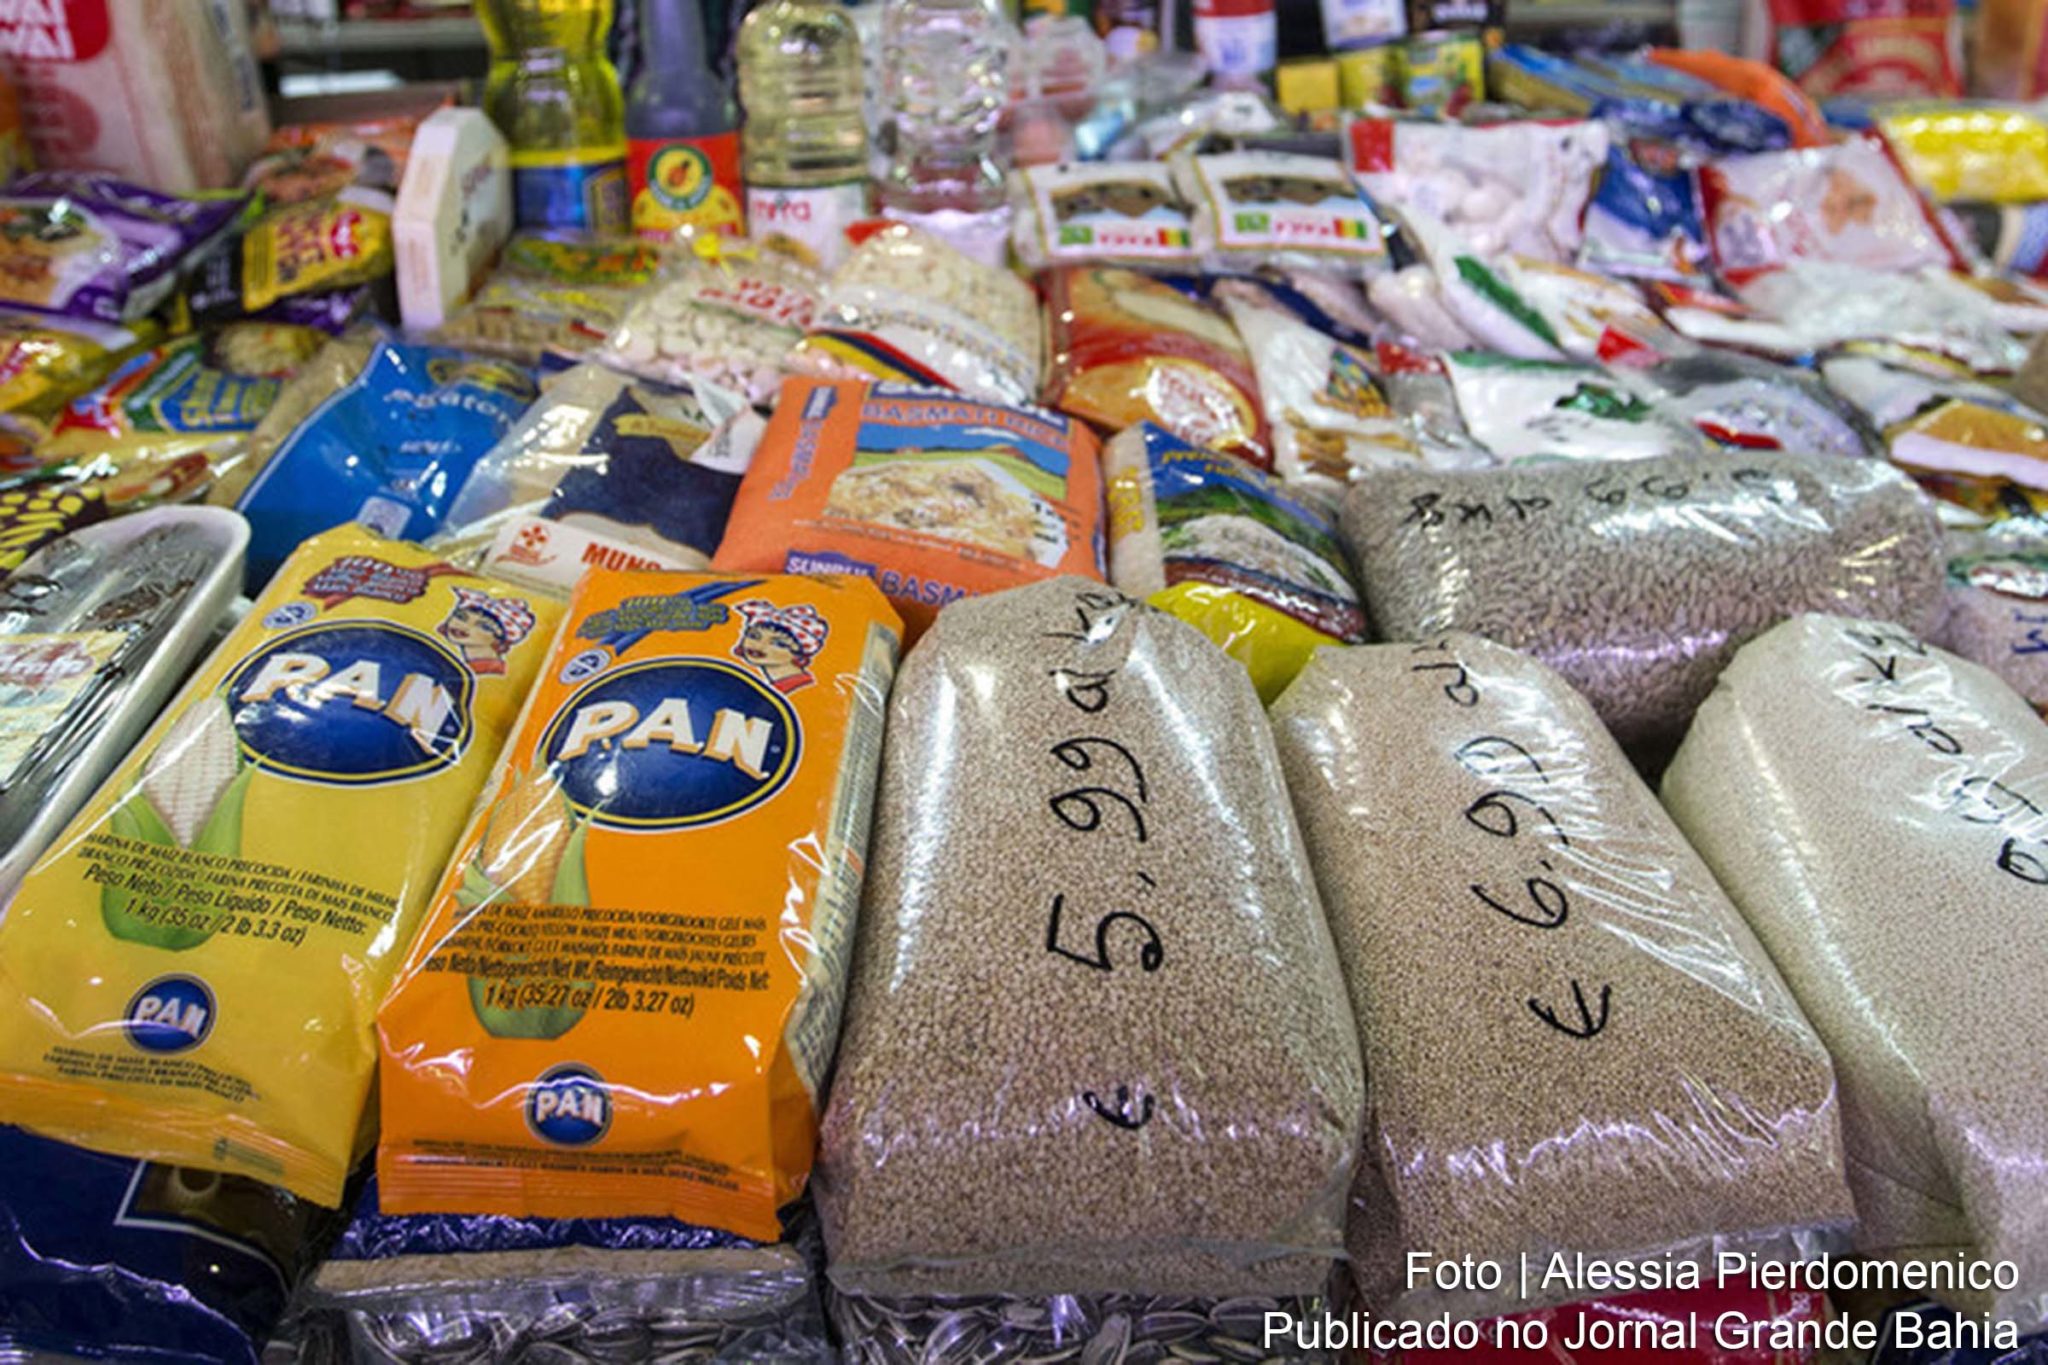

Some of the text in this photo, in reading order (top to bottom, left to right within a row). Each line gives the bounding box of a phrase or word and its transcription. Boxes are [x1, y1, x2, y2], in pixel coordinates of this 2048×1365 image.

[82, 862, 126, 886] Peso
[125, 872, 165, 898] Neto
[174, 881, 214, 906] Peso
[281, 898, 322, 924] Peso
[632, 989, 669, 1013] 3.27
